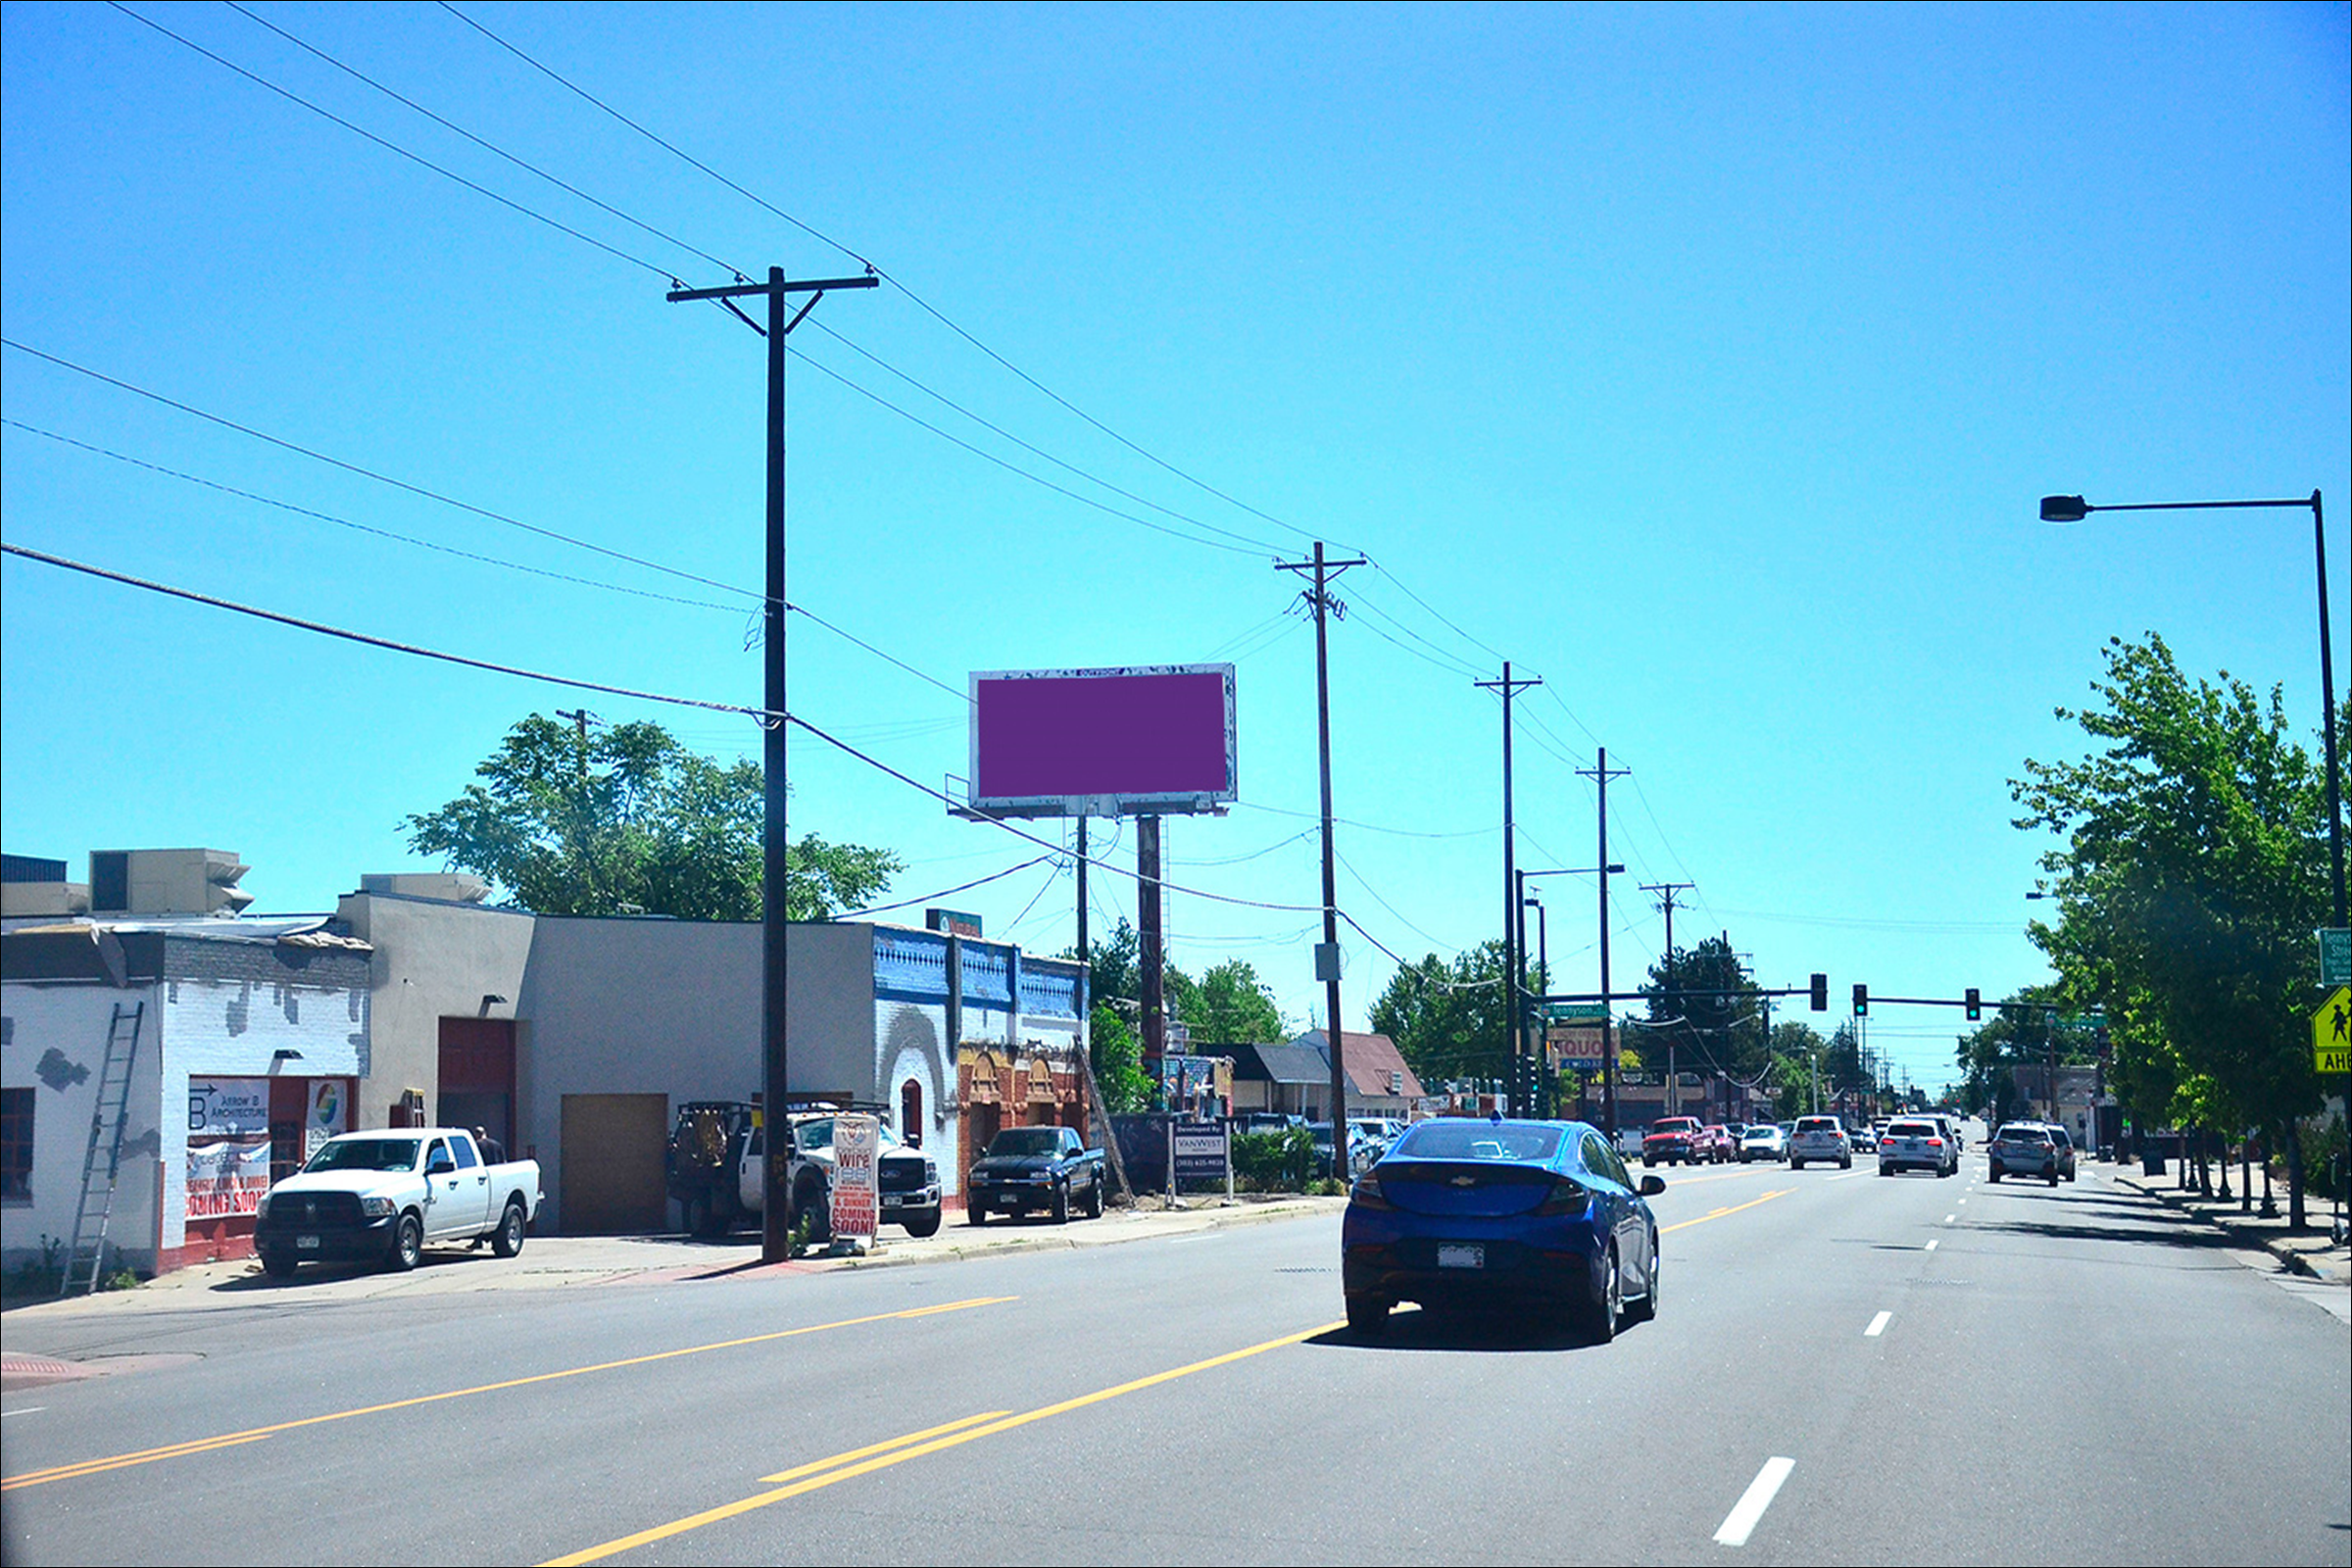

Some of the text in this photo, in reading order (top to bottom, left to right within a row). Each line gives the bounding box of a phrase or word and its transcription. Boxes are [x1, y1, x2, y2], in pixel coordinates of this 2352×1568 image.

[189, 1097, 207, 1130] B
[832, 1208, 875, 1221] COMING
[831, 1219, 874, 1235] SOON!
